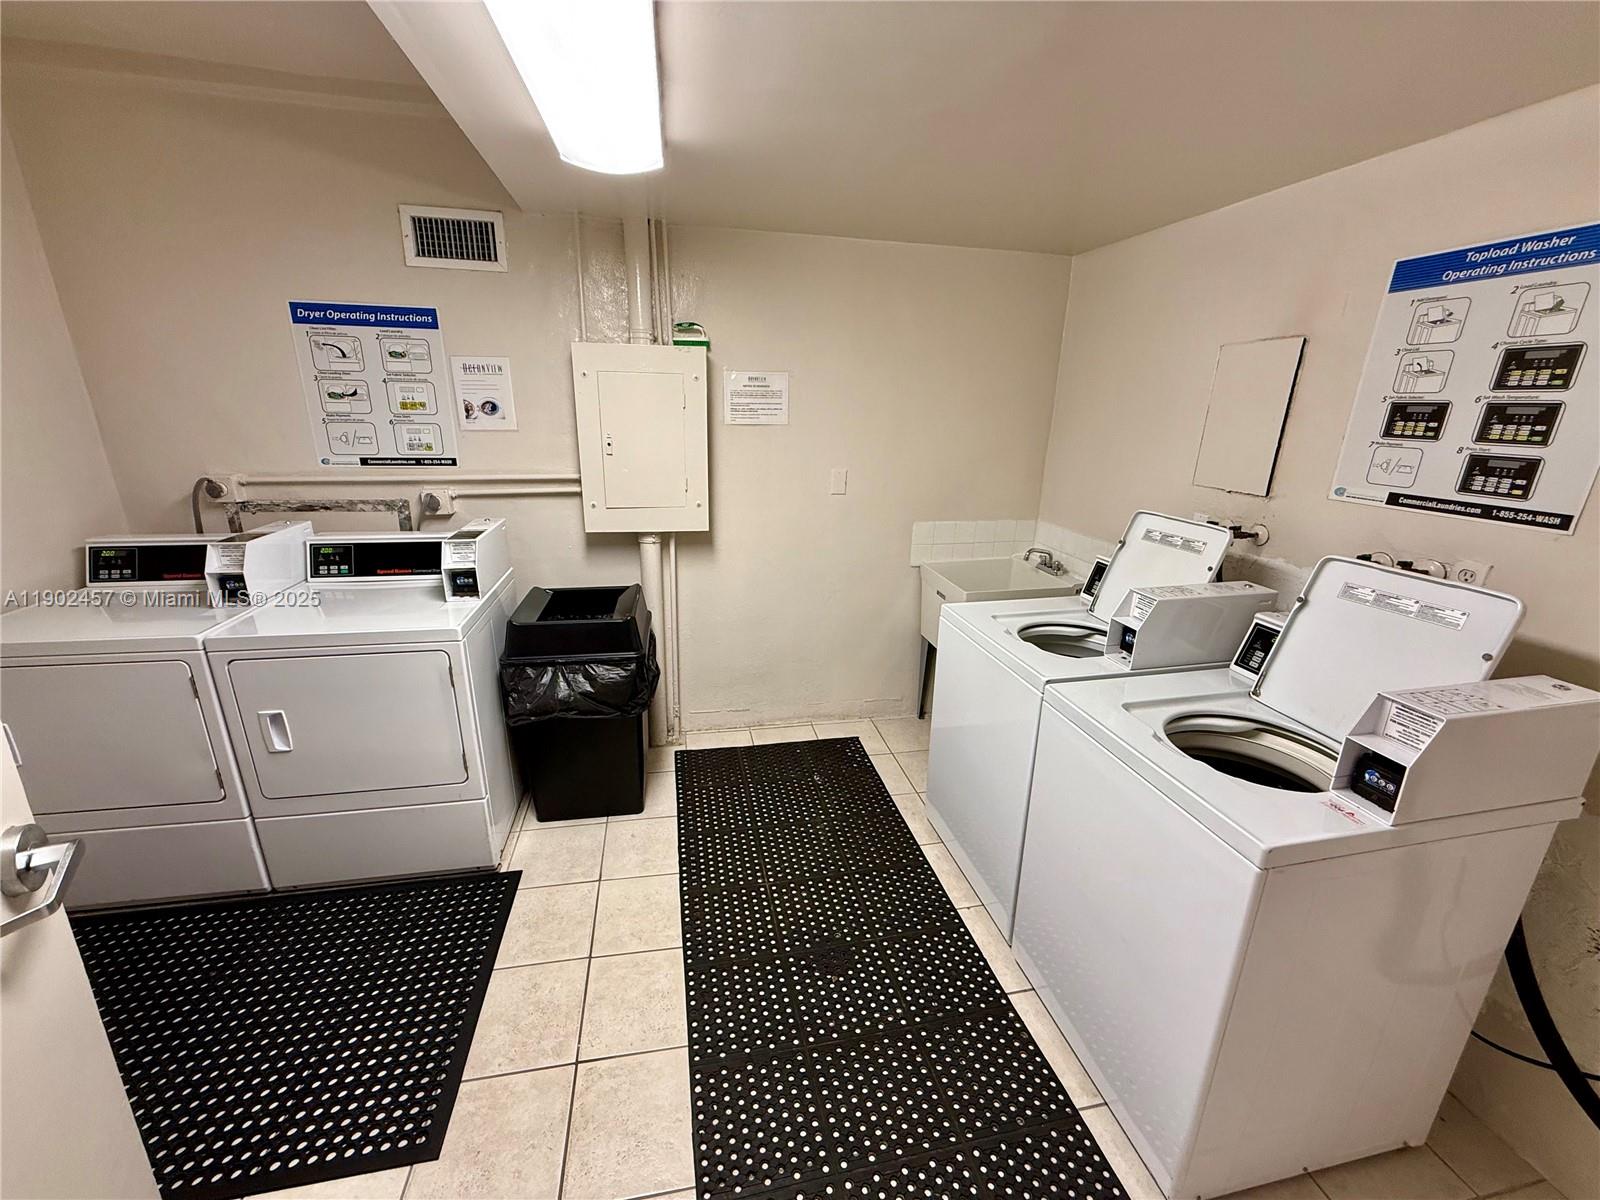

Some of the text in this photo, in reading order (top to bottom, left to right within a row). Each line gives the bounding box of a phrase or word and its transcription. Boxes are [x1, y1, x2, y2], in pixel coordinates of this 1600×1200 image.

[1466, 236, 1576, 262] Topload Washer
[1442, 250, 1597, 282] Operating Instructions
[1510, 286, 1519, 294] 2
[297, 309, 432, 322] Dryer Operating Instructions
[1398, 496, 1482, 514] CommercialLaundries.com
[1492, 509, 1561, 525] 1-855-254-WASH
